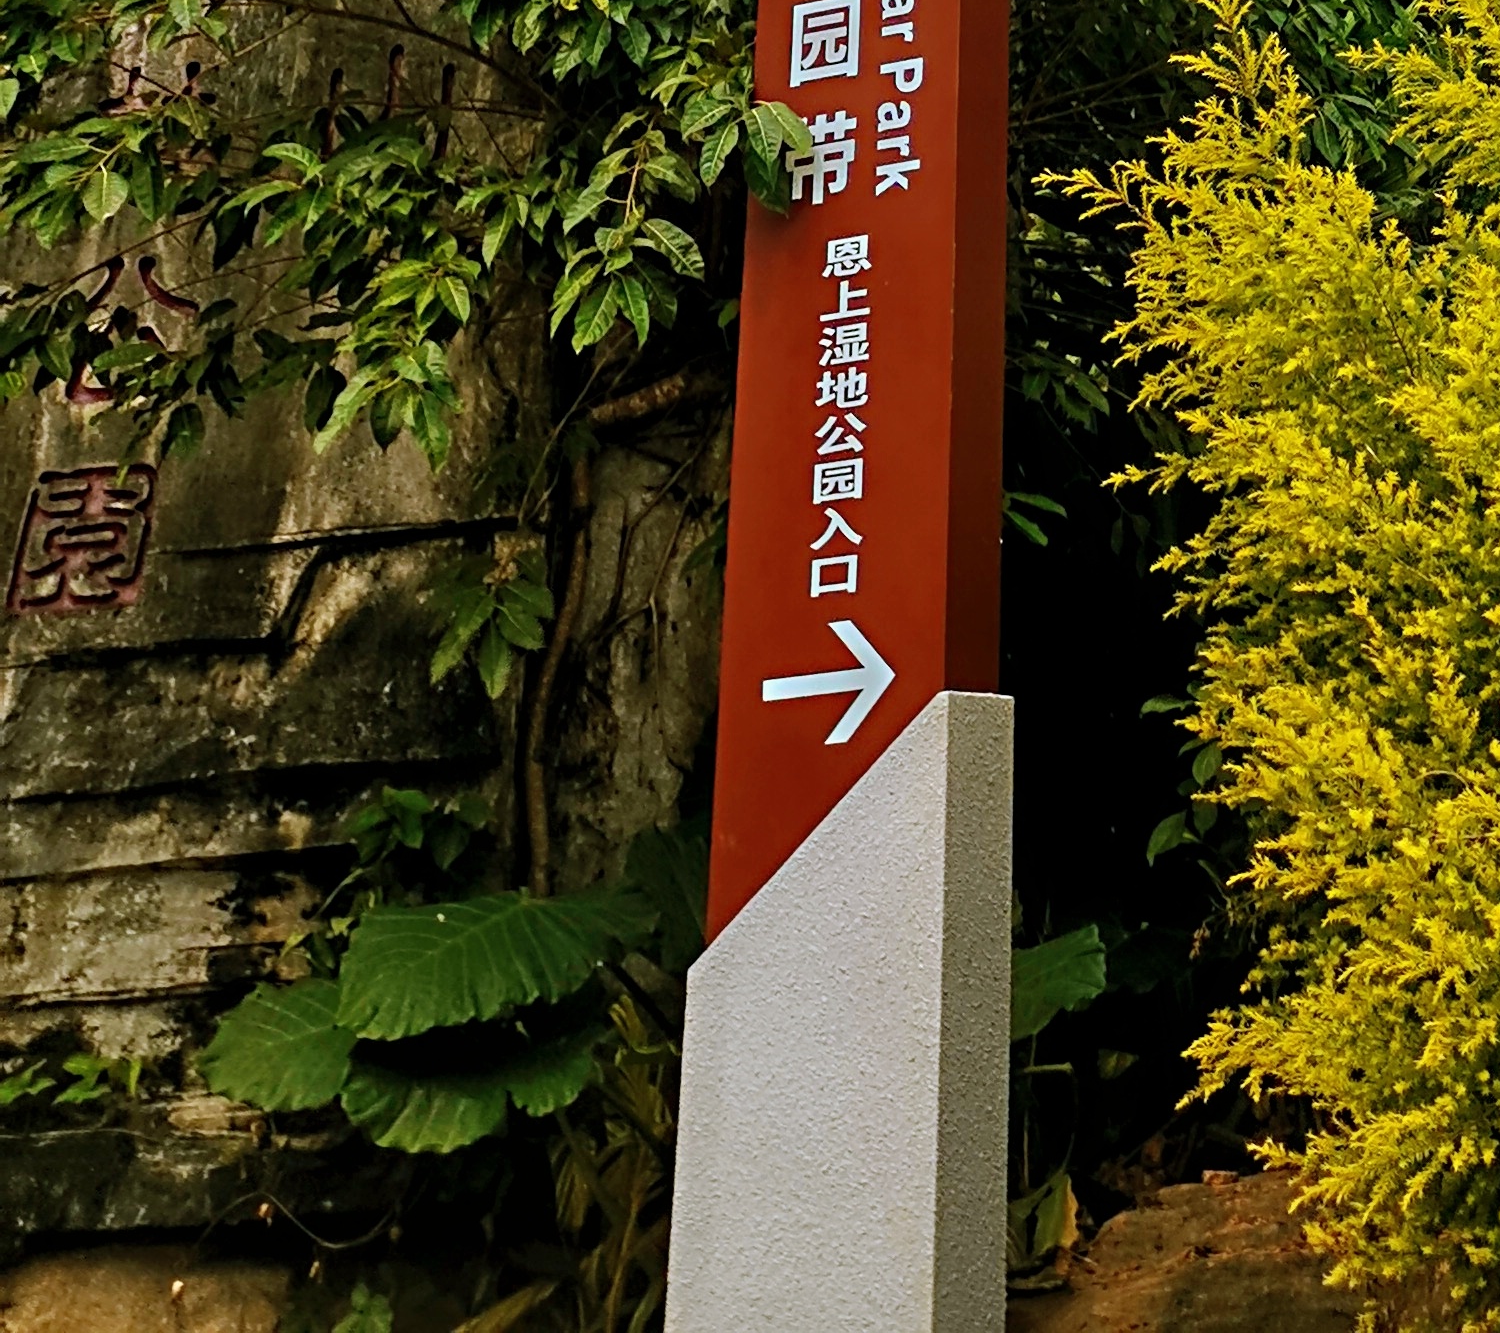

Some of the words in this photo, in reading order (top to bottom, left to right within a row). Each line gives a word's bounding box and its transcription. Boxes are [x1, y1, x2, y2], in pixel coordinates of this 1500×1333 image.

[875, 57, 924, 197] Park
[809, 234, 873, 598] 恩上湿地公园入口
